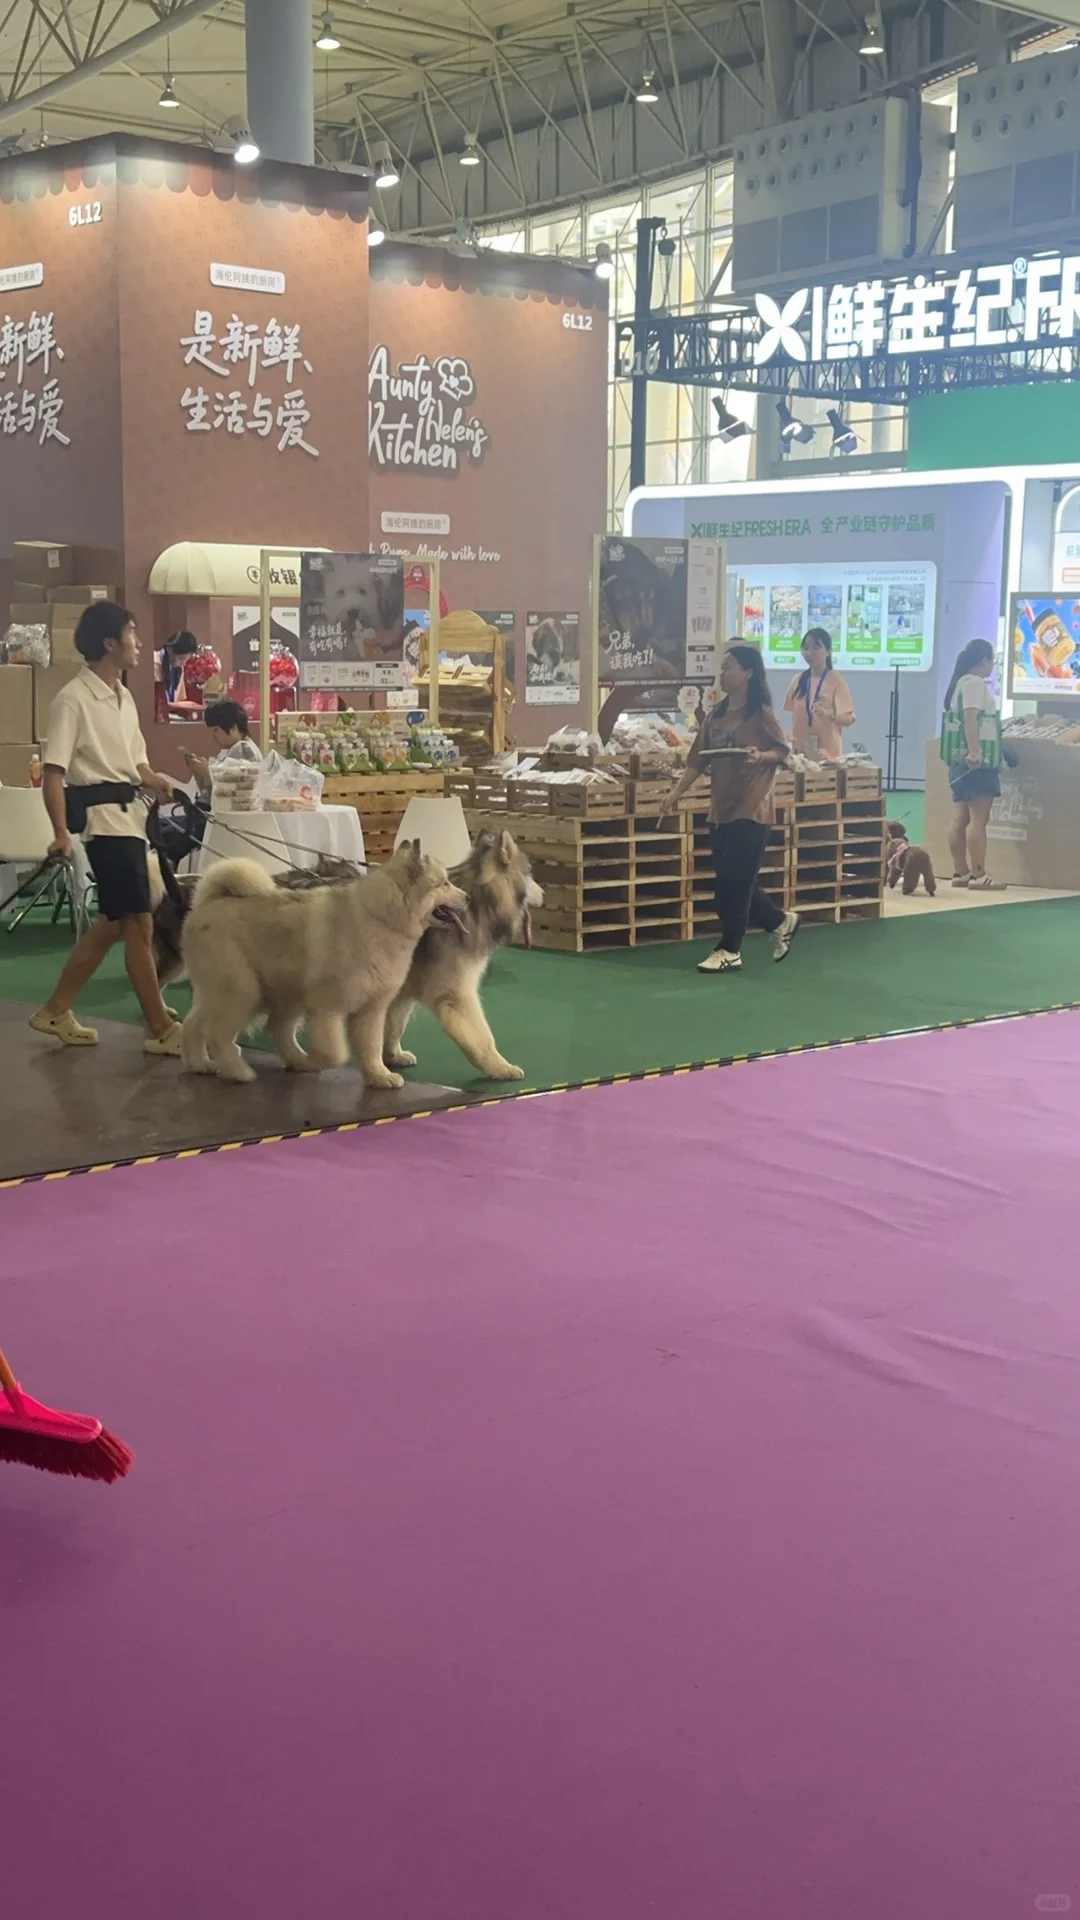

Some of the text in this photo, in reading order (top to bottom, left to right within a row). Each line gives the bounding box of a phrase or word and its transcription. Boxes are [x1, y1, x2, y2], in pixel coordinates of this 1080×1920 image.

[69, 202, 102, 227] 6L12
[0, 311, 64, 385] 新鲜、
[562, 313, 593, 331] 6L12
[368, 346, 436, 414] Aunty
[180, 387, 320, 457] 生活与爱
[368, 401, 457, 469] Kitchen
[426, 399, 488, 458] Helen's
[417, 543, 449, 561] Made
[451, 545, 476, 561] with
[478, 546, 501, 561] love
[819, 513, 935, 534] 全产业链守护品质
